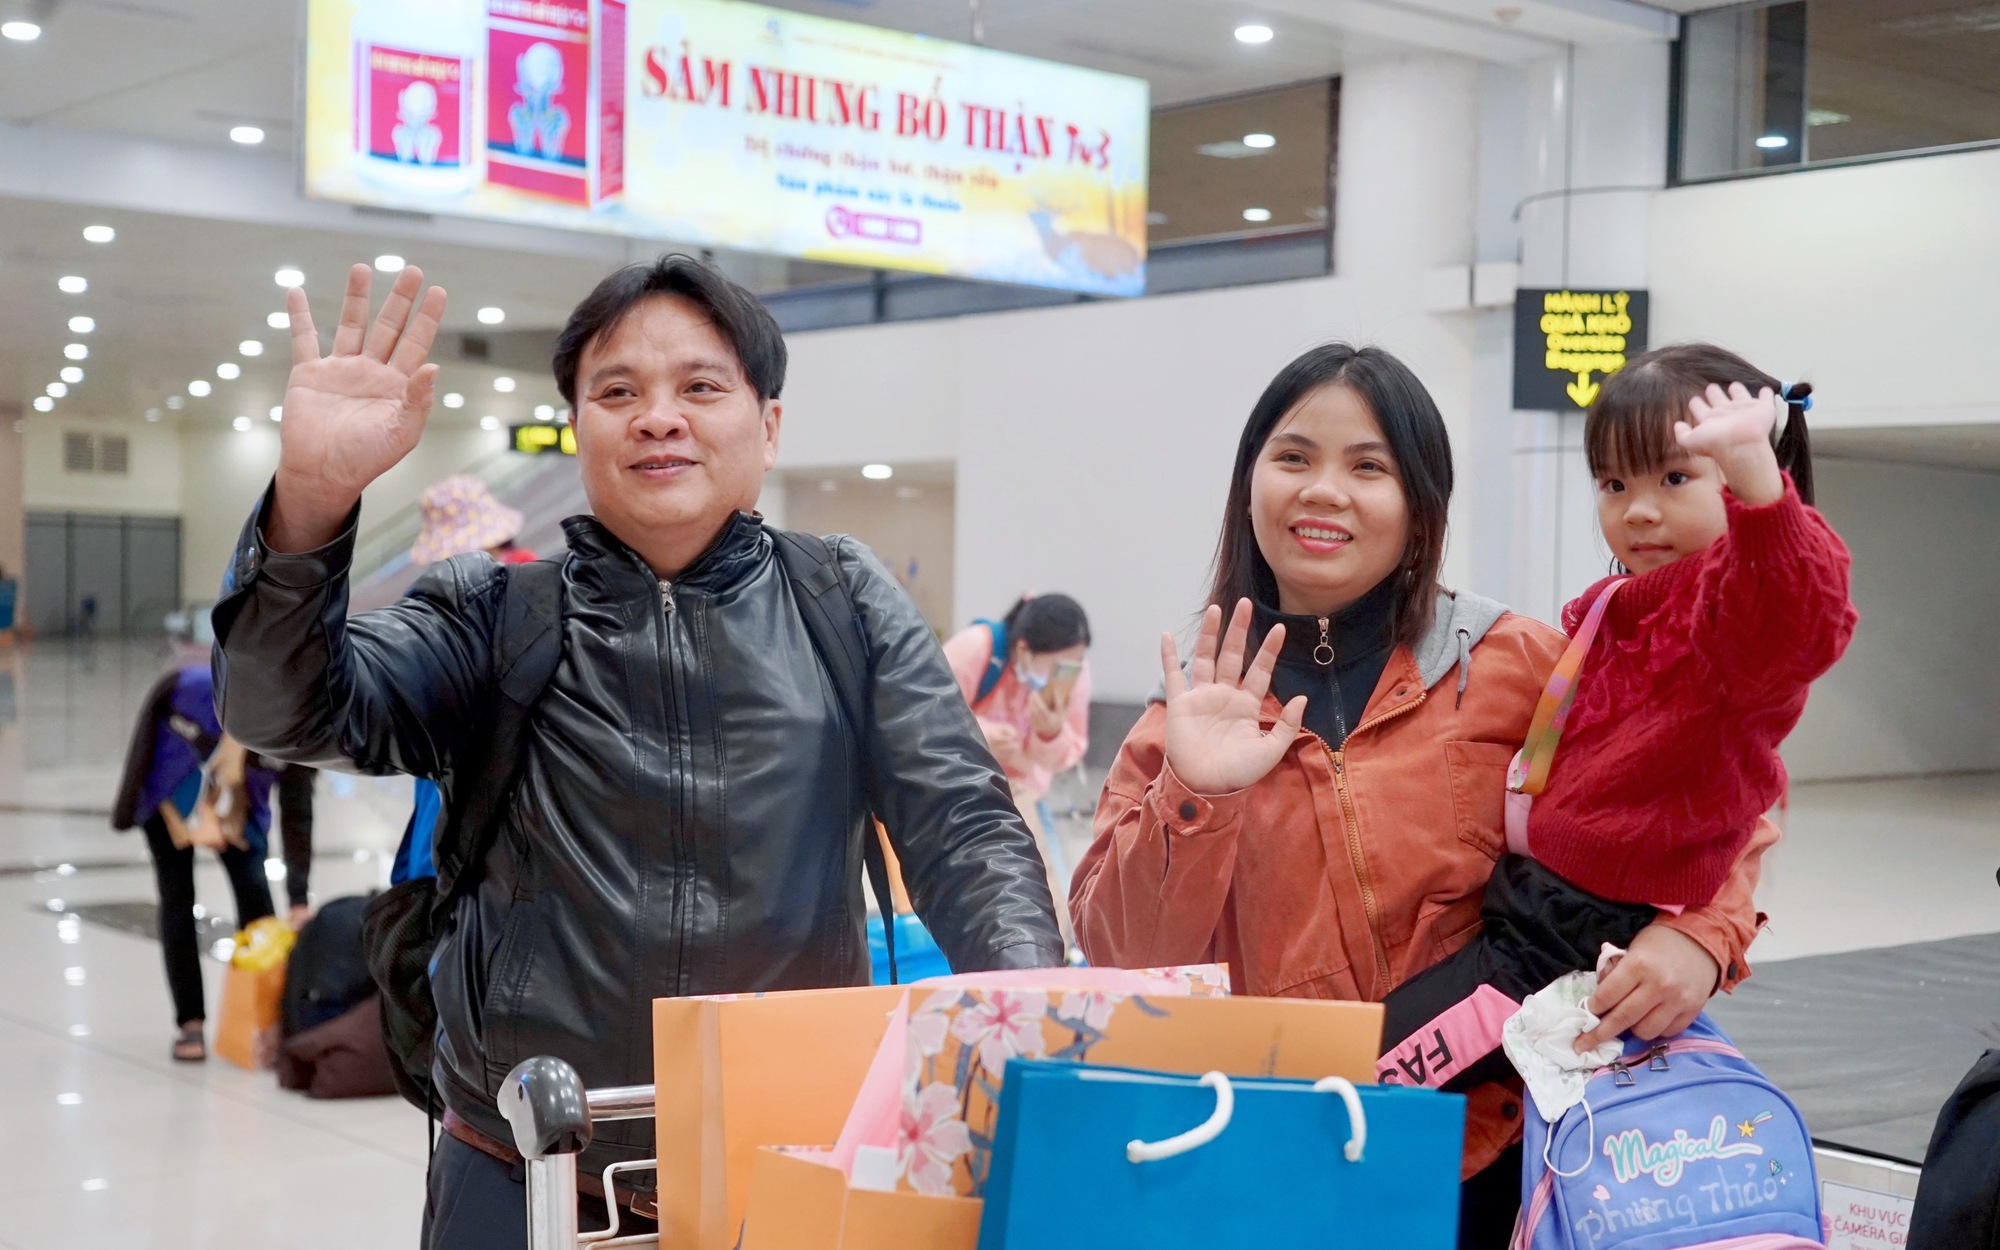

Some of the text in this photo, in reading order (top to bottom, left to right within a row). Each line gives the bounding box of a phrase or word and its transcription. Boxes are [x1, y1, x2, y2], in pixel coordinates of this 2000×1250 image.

[746, 66, 879, 130] NHUNG
[961, 101, 1054, 172] THẬN
[1604, 1116, 1762, 1187] Magical
[1700, 1163, 1778, 1214] Thảo
[1849, 1203, 1906, 1228] KHU VỰC
